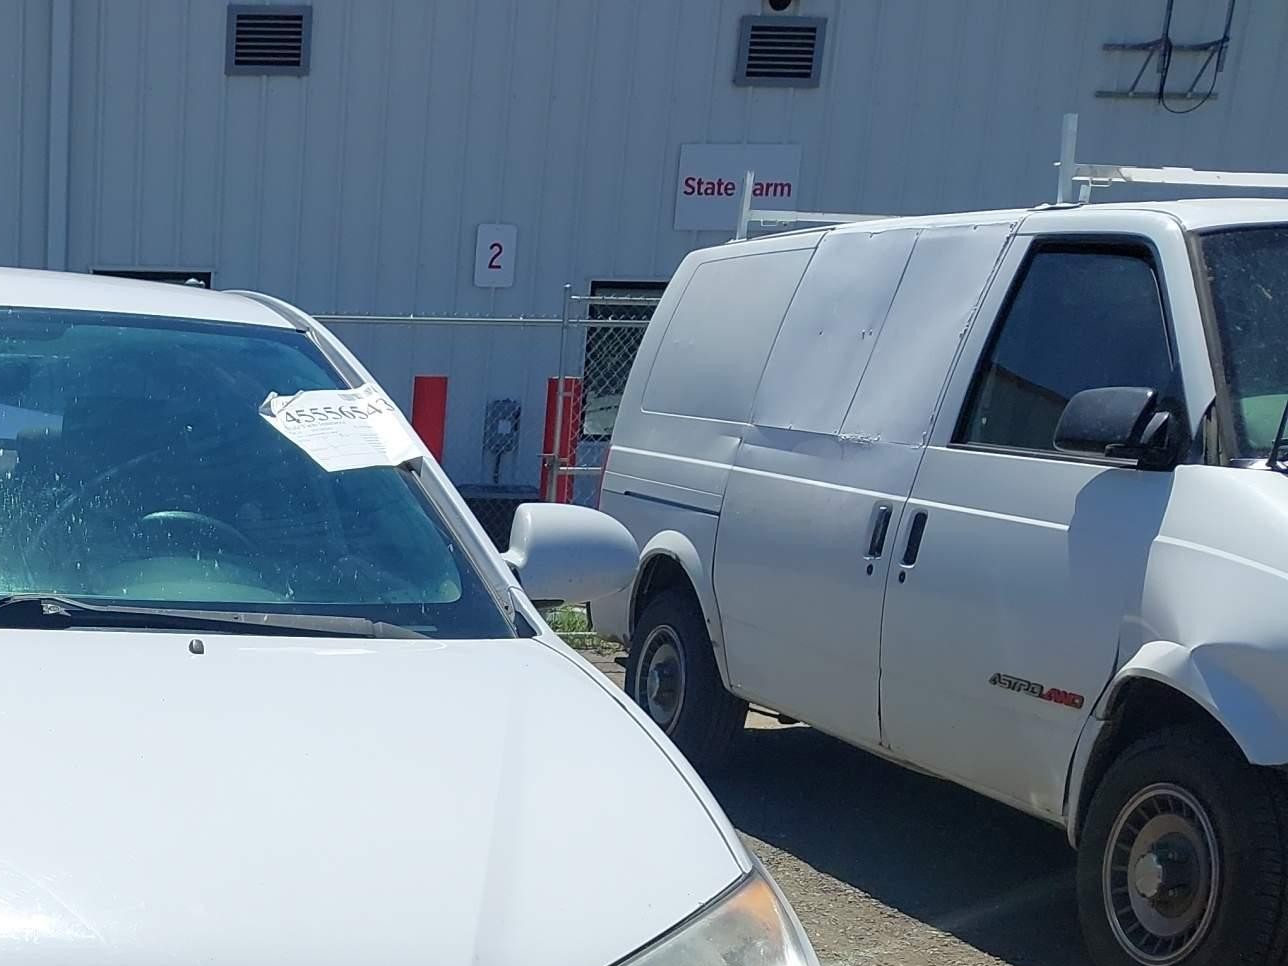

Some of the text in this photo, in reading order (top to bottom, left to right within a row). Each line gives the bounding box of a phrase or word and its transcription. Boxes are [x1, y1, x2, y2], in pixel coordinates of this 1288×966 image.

[683, 176, 793, 198] State arm
[488, 242, 503, 269] 2
[285, 398, 395, 424] 45556543
